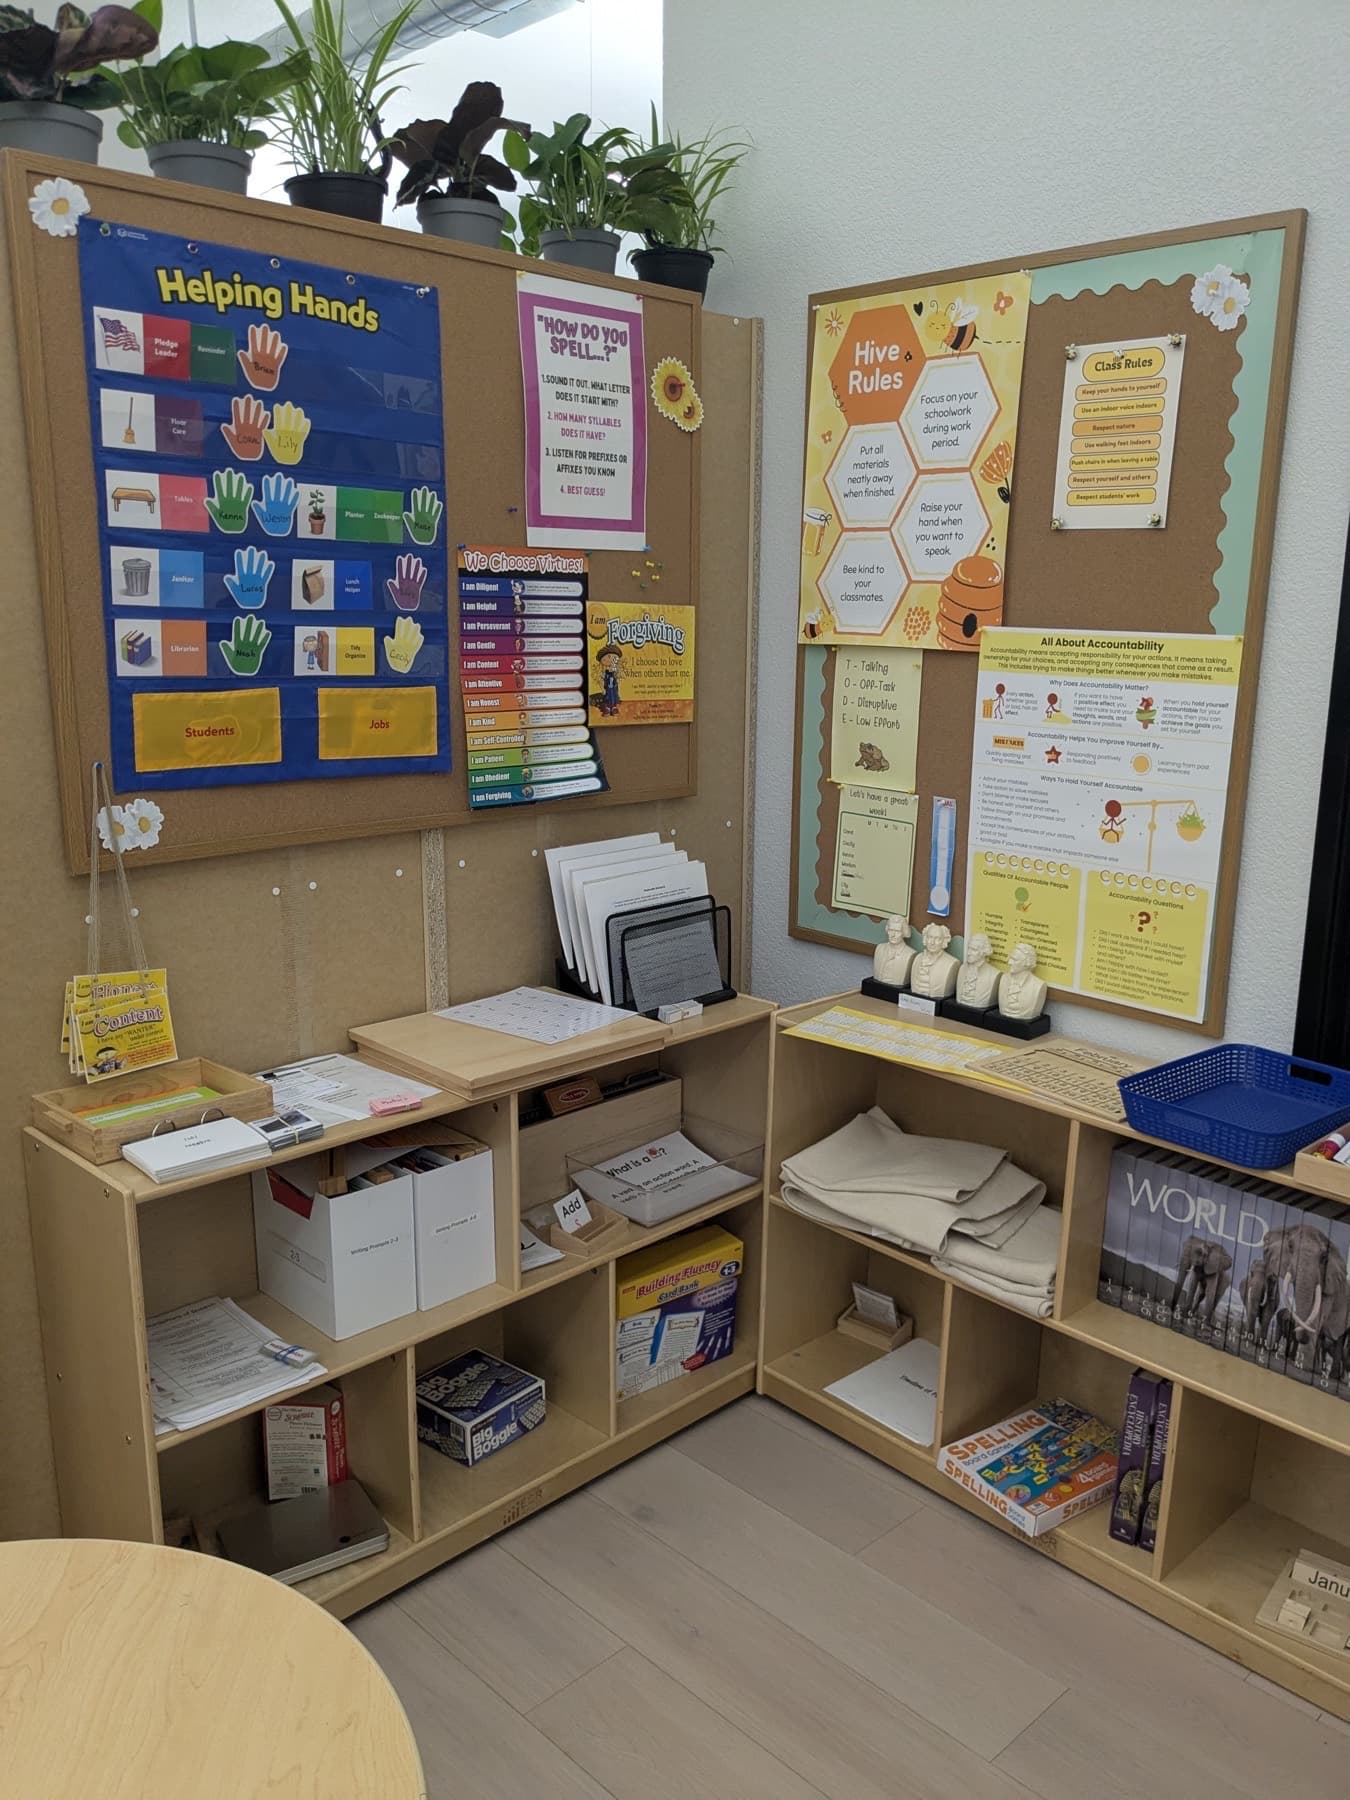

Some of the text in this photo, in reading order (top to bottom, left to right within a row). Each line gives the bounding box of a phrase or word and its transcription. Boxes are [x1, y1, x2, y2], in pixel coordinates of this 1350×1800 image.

[156, 268, 380, 333] Helping Hands
[581, 322, 600, 342] DO
[602, 326, 628, 348] YOU
[154, 338, 178, 348] Pledge
[154, 348, 178, 358] Leader
[854, 340, 900, 366] Hive
[1094, 358, 1153, 372] Class Rules
[848, 369, 904, 395] Rules
[1136, 382, 1160, 392] yourself
[555, 391, 619, 408] DOES IT START WITH?
[920, 394, 944, 405] Focus
[958, 391, 978, 404] your
[547, 412, 622, 428] 2. HOW MANY SYLLABLES
[924, 408, 972, 420] schoolwork
[172, 428, 186, 436] Care
[560, 428, 606, 441] DOES IT HAVE?
[922, 422, 972, 436] during work
[278, 436, 298, 454] Lily
[860, 445, 884, 456] Put all
[932, 437, 960, 450] period.
[546, 448, 628, 464] 3. LISTEN FOR PREFIXES OR
[556, 464, 616, 477] AFFIXES YOU KNOW
[852, 459, 890, 470] materials
[847, 474, 894, 486] neatly away
[560, 486, 606, 497] 4. BEST GUESS!
[843, 488, 895, 498] when finished.
[920, 502, 963, 514] Raise your
[918, 516, 962, 526] hand when
[915, 532, 964, 544] you want to
[924, 546, 951, 558] speak.
[464, 551, 584, 574] We Choose Virtues!
[842, 564, 884, 574] Bee kind to
[172, 575, 194, 584] Janitor
[854, 580, 872, 590] your
[240, 584, 264, 593] Lucas
[840, 592, 884, 602] classmates.
[608, 611, 685, 654] Forgiving
[1041, 638, 1164, 653] All About Accountability
[990, 647, 1028, 656] Accountability
[1050, 650, 1080, 658] accepting
[1080, 652, 1122, 660] responsibility
[1205, 657, 1227, 666] taking
[624, 669, 642, 678] when
[644, 668, 664, 678] others
[664, 668, 678, 678] hurt
[846, 659, 888, 676] T Talking
[1076, 666, 1094, 675] things
[1080, 682, 1123, 690] Accountability
[1124, 684, 1149, 692] Matter?
[842, 696, 898, 711] D Disruptive
[185, 726, 235, 738] Students
[369, 720, 390, 730] Jobs
[1080, 779, 1104, 787] Yourself
[1104, 782, 1144, 792] Accountable
[486, 792, 512, 802] Forgiving
[1108, 891, 1184, 910] Accountability Questions
[94, 1006, 163, 1038] Content
[606, 1156, 652, 1178] What is a
[562, 1199, 581, 1218] Add
[1126, 1172, 1270, 1248] WORLD
[636, 1271, 682, 1298] Building
[683, 1260, 722, 1277] Fluency
[1122, 1392, 1138, 1456] ENCYCLOPEDIA
[1132, 1410, 1144, 1447] HISTORY
[472, 1426, 494, 1447] Big
[947, 1414, 1047, 1464] SPELLING
[1152, 1401, 1168, 1466] ENCYCLOPEDIA
[474, 1422, 518, 1460] Boggle
[987, 1442, 1014, 1458] Games
[944, 1458, 1008, 1516] SPELLING
[1308, 1570, 1350, 1598] Janu
